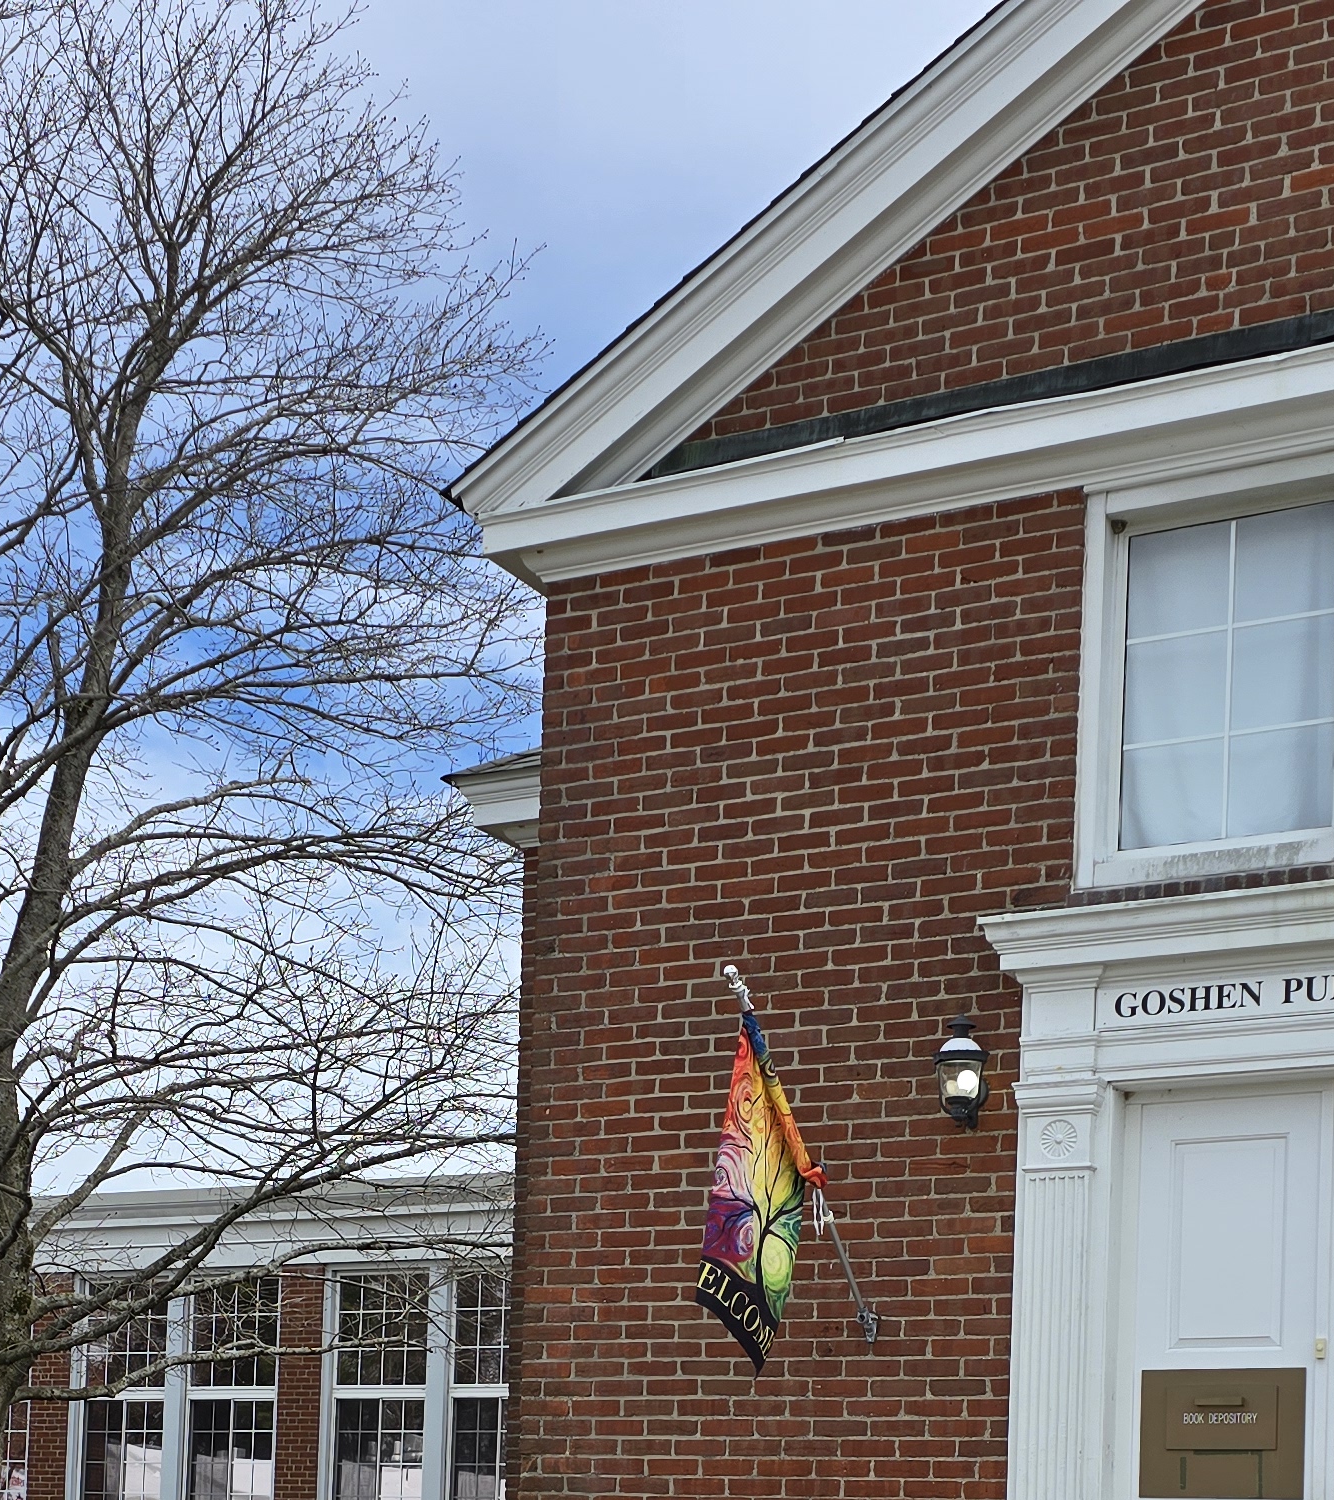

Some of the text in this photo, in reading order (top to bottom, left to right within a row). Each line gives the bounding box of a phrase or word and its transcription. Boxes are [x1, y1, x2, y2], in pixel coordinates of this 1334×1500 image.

[1114, 980, 1263, 1018] GOSHEN
[1183, 1412, 1258, 1424] BOOK DEPOSITORY
